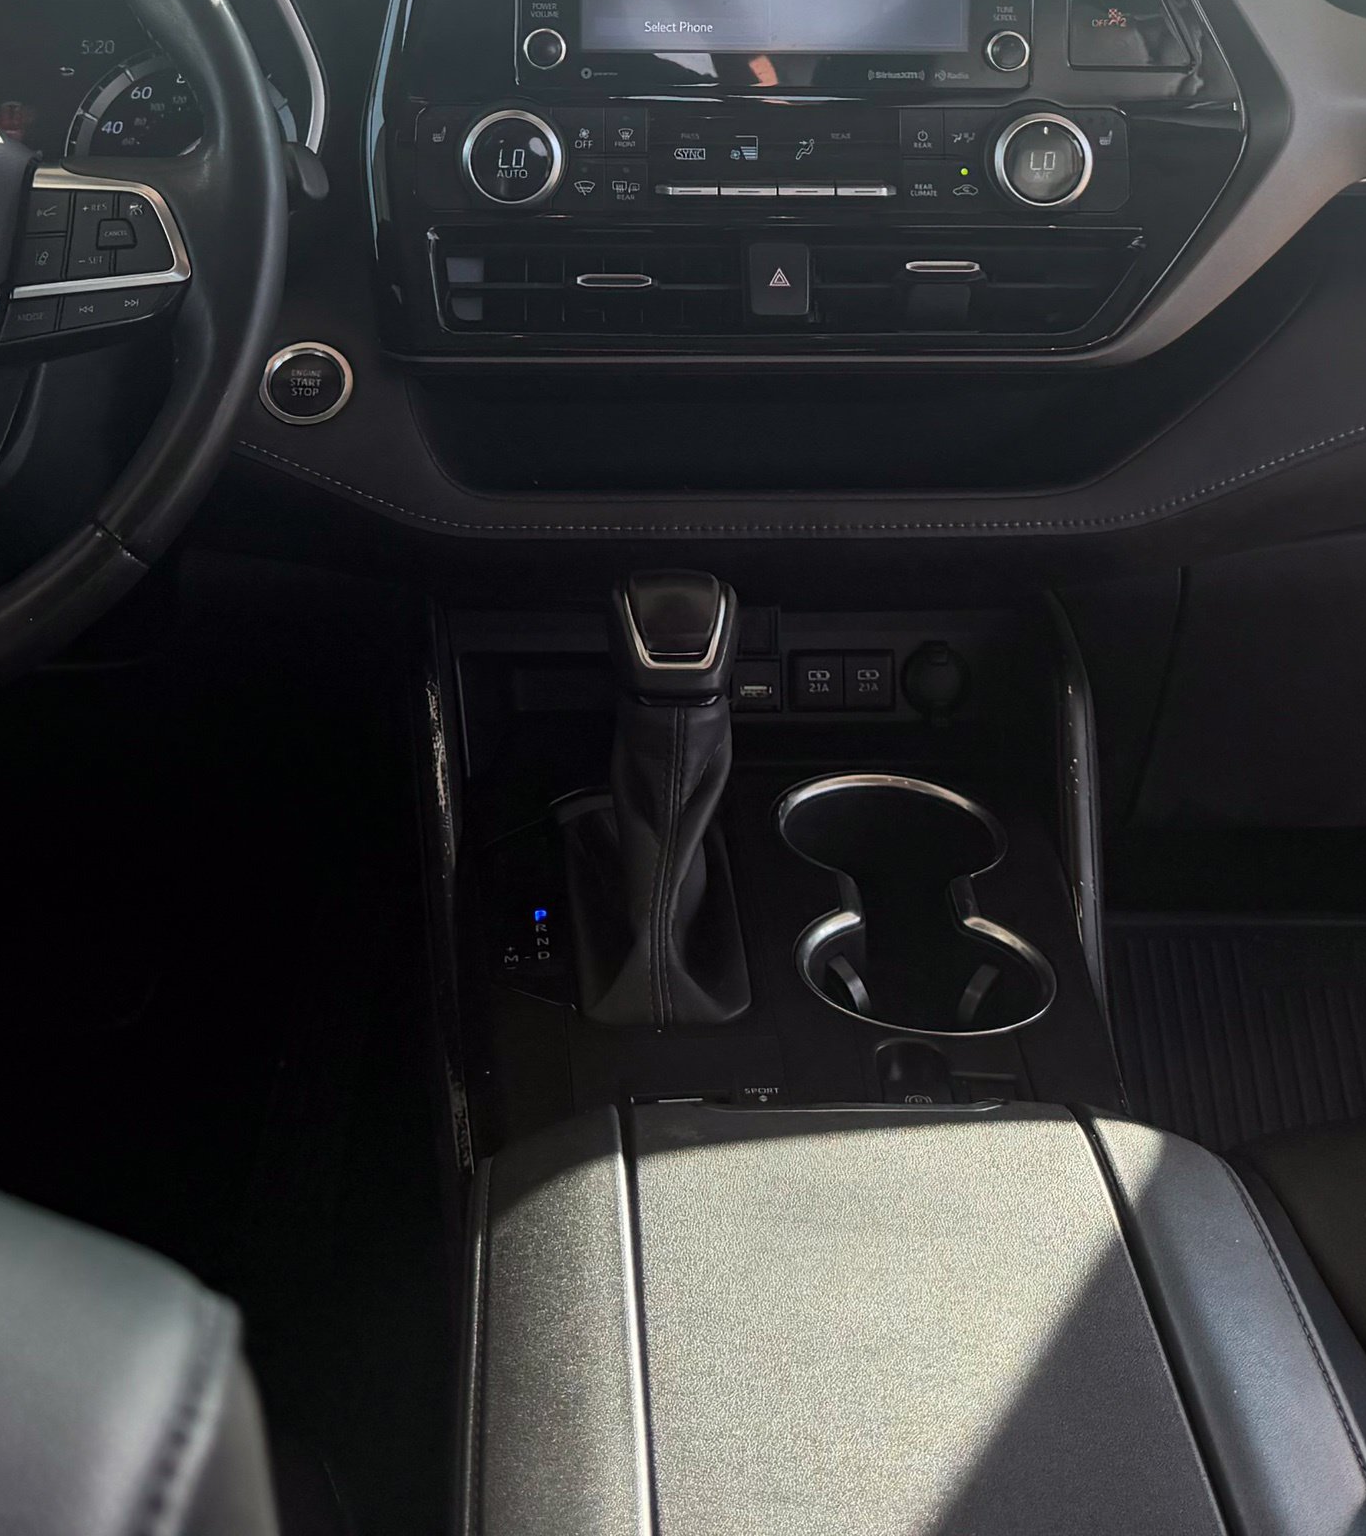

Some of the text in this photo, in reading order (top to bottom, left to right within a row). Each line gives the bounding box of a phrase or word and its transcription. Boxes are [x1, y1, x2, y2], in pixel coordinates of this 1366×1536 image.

[644, 20, 713, 33] Select Phone
[80, 39, 116, 55] 5:20
[130, 86, 153, 100] 60
[101, 120, 124, 135] 40
[573, 140, 593, 149] OFF
[497, 148, 525, 169] LO
[676, 149, 705, 159] SYNC
[496, 169, 529, 179] AUTO
[914, 183, 934, 191] REAR
[910, 190, 938, 198] CLIMATE
[289, 378, 323, 387] START
[290, 387, 320, 397] STOP
[534, 909, 547, 922] P
[535, 923, 548, 933] R
[536, 937, 550, 946] N
[537, 951, 551, 960] D
[743, 1087, 780, 1095] SPORT
